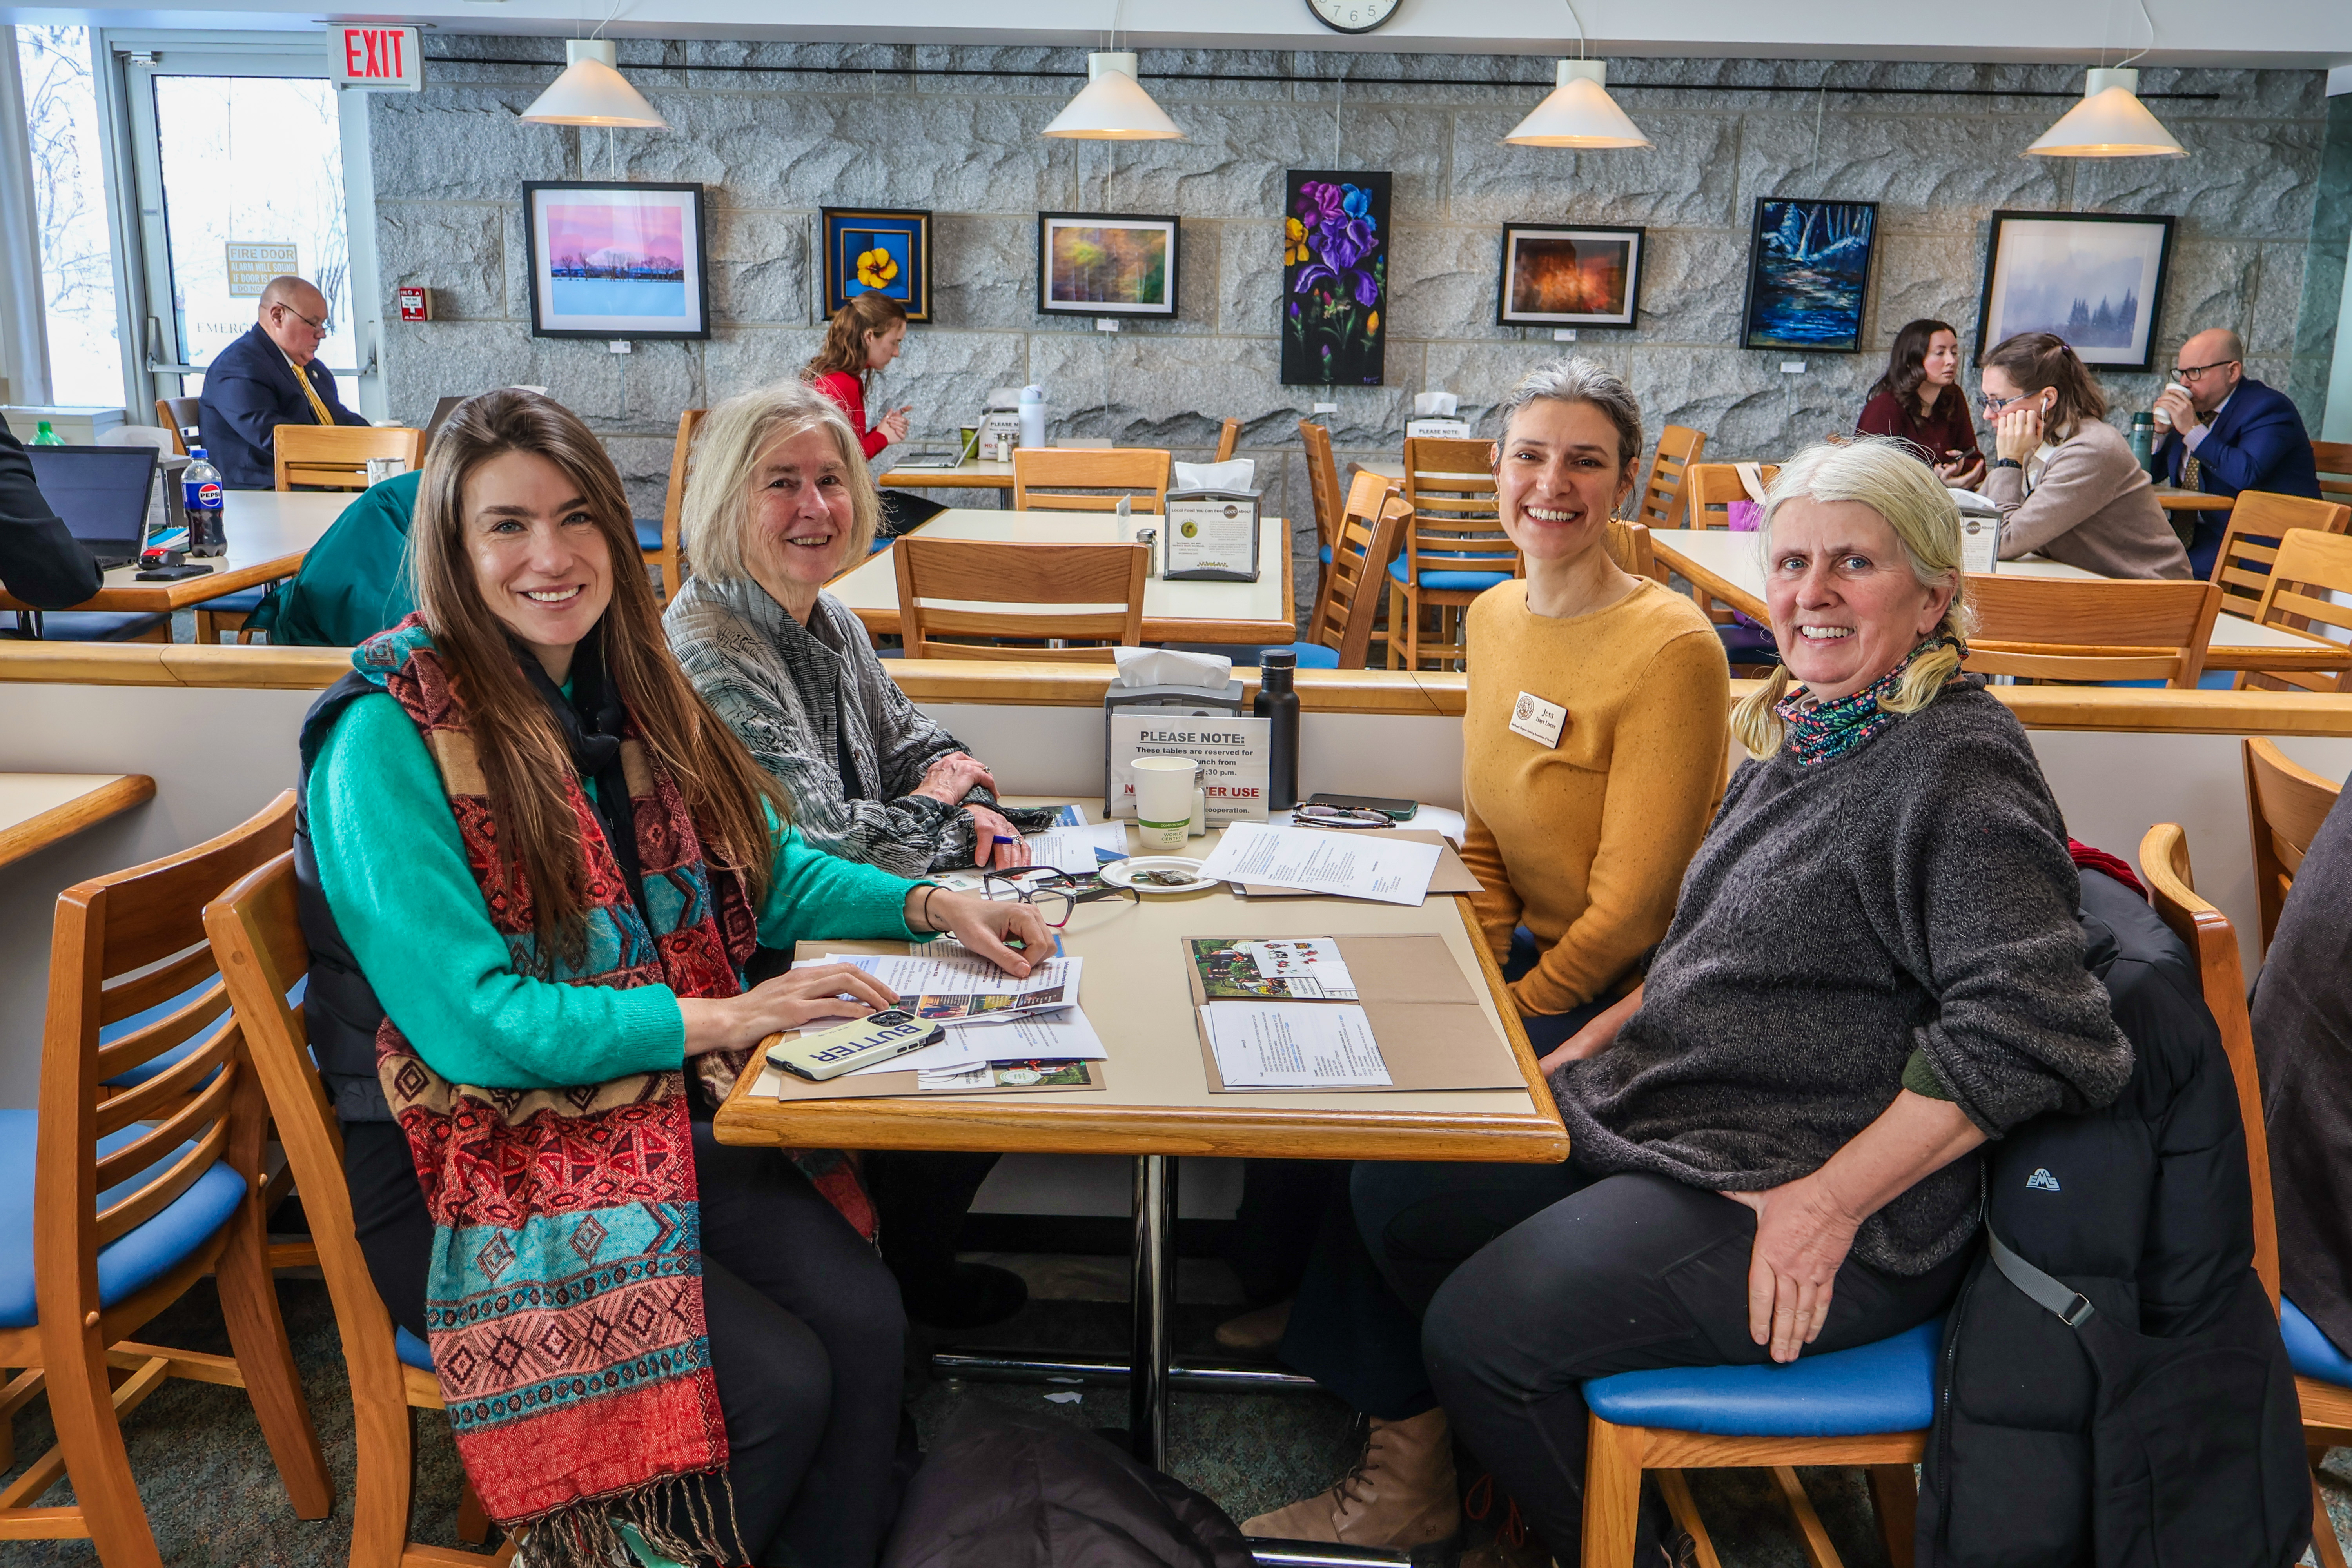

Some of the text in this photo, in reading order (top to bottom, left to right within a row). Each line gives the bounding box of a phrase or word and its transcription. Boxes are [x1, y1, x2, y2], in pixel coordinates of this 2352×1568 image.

[1334, 5, 1341, 16] 7
[1350, 10, 1358, 21] 6
[1368, 5, 1376, 16] 5
[345, 29, 404, 78] EXIT
[231, 249, 294, 259] FIRE DOOR
[231, 262, 295, 272] ALARM WILL SOUND
[233, 274, 240, 282] IF
[241, 274, 259, 283] DOOR
[261, 275, 268, 283] IS
[1542, 709, 1553, 719] Jess
[1140, 731, 1245, 744] PLEASE NOTE:
[1125, 784, 1135, 793] N
[1232, 788, 1259, 797] USE
[808, 1024, 922, 1062] BUTTER
[2027, 1170, 2060, 1189] EMS
